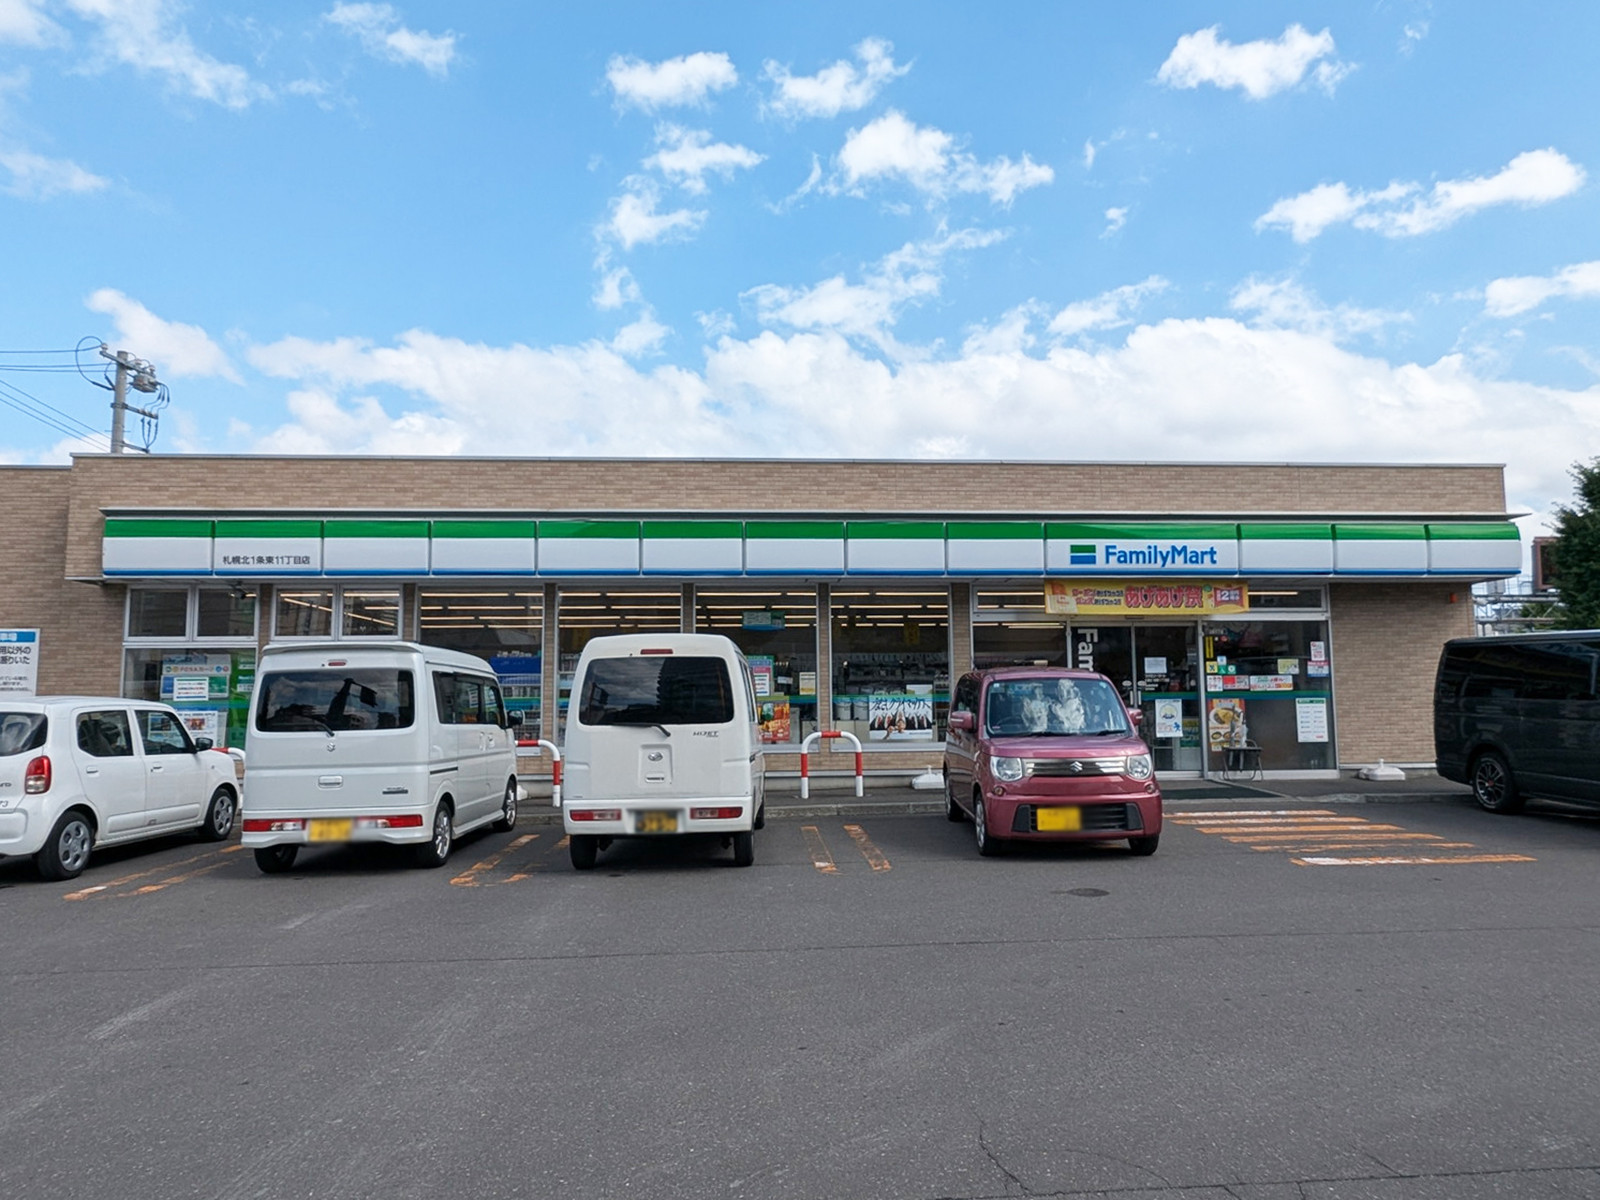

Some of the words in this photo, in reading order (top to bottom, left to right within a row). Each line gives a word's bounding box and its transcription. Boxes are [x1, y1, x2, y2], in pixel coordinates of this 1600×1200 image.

[223, 556, 310, 565] 札幌北1条東11丁目店
[1105, 545, 1217, 567] FamilyMart
